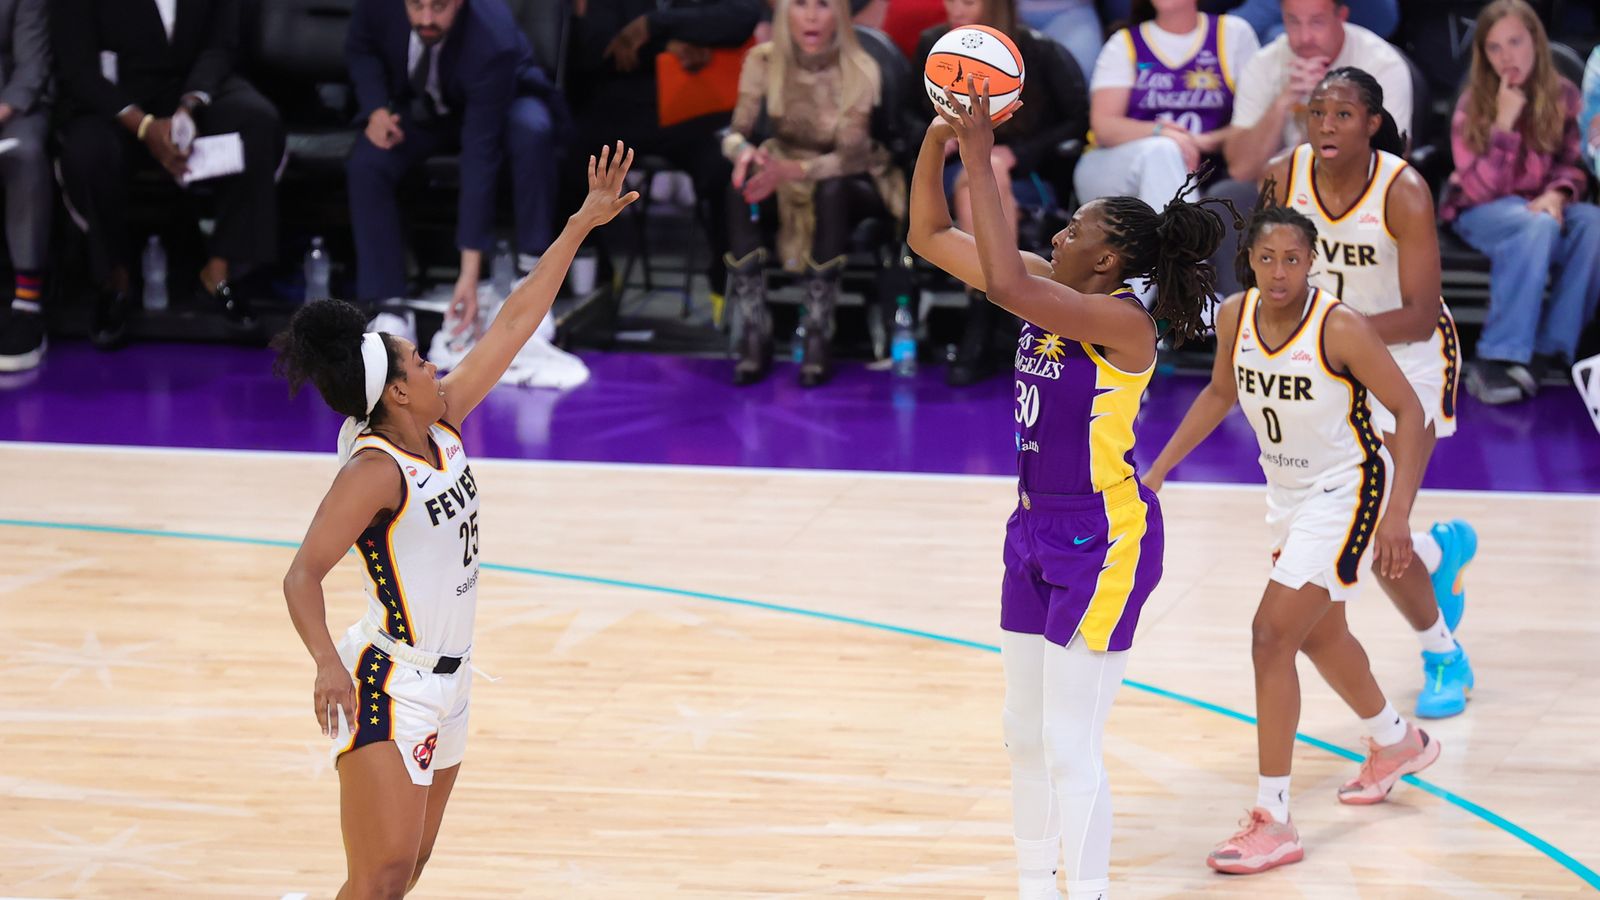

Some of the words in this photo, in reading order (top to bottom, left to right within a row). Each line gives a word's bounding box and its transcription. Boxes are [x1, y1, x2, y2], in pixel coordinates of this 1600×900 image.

[1137, 68, 1174, 89] Los
[1155, 111, 1203, 136] 0
[1321, 238, 1378, 267] VER
[1238, 366, 1315, 401] FEVER
[1015, 380, 1040, 428] 30
[1262, 407, 1282, 444] 0
[459, 510, 478, 567] 25
